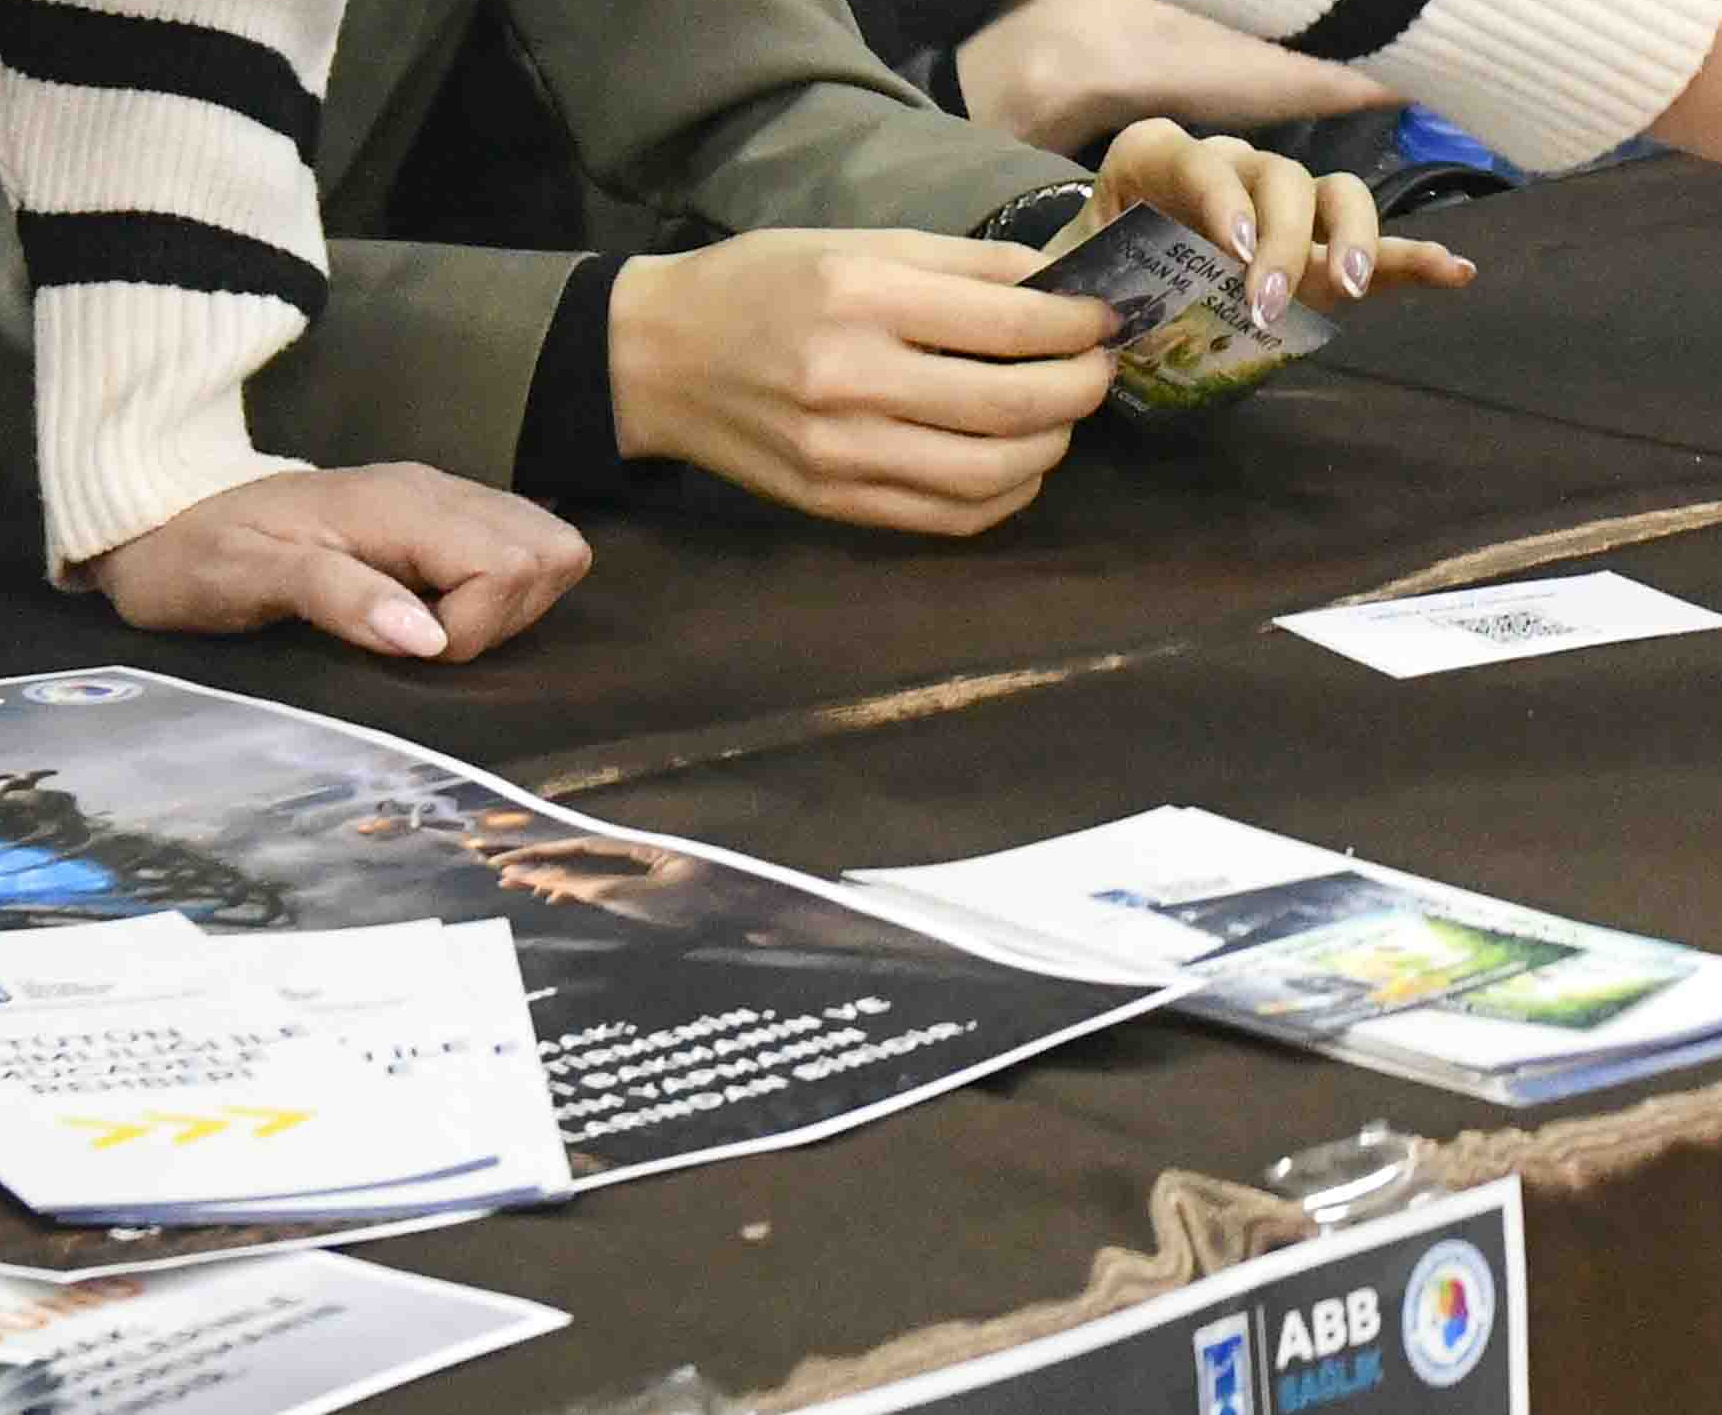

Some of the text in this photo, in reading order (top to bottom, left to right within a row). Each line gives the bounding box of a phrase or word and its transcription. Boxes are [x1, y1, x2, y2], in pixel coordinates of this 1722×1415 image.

[1165, 241, 1224, 283] SEÇİM
[1200, 294, 1251, 335] SAĞLIK
[1276, 1285, 1382, 1370] ABB
